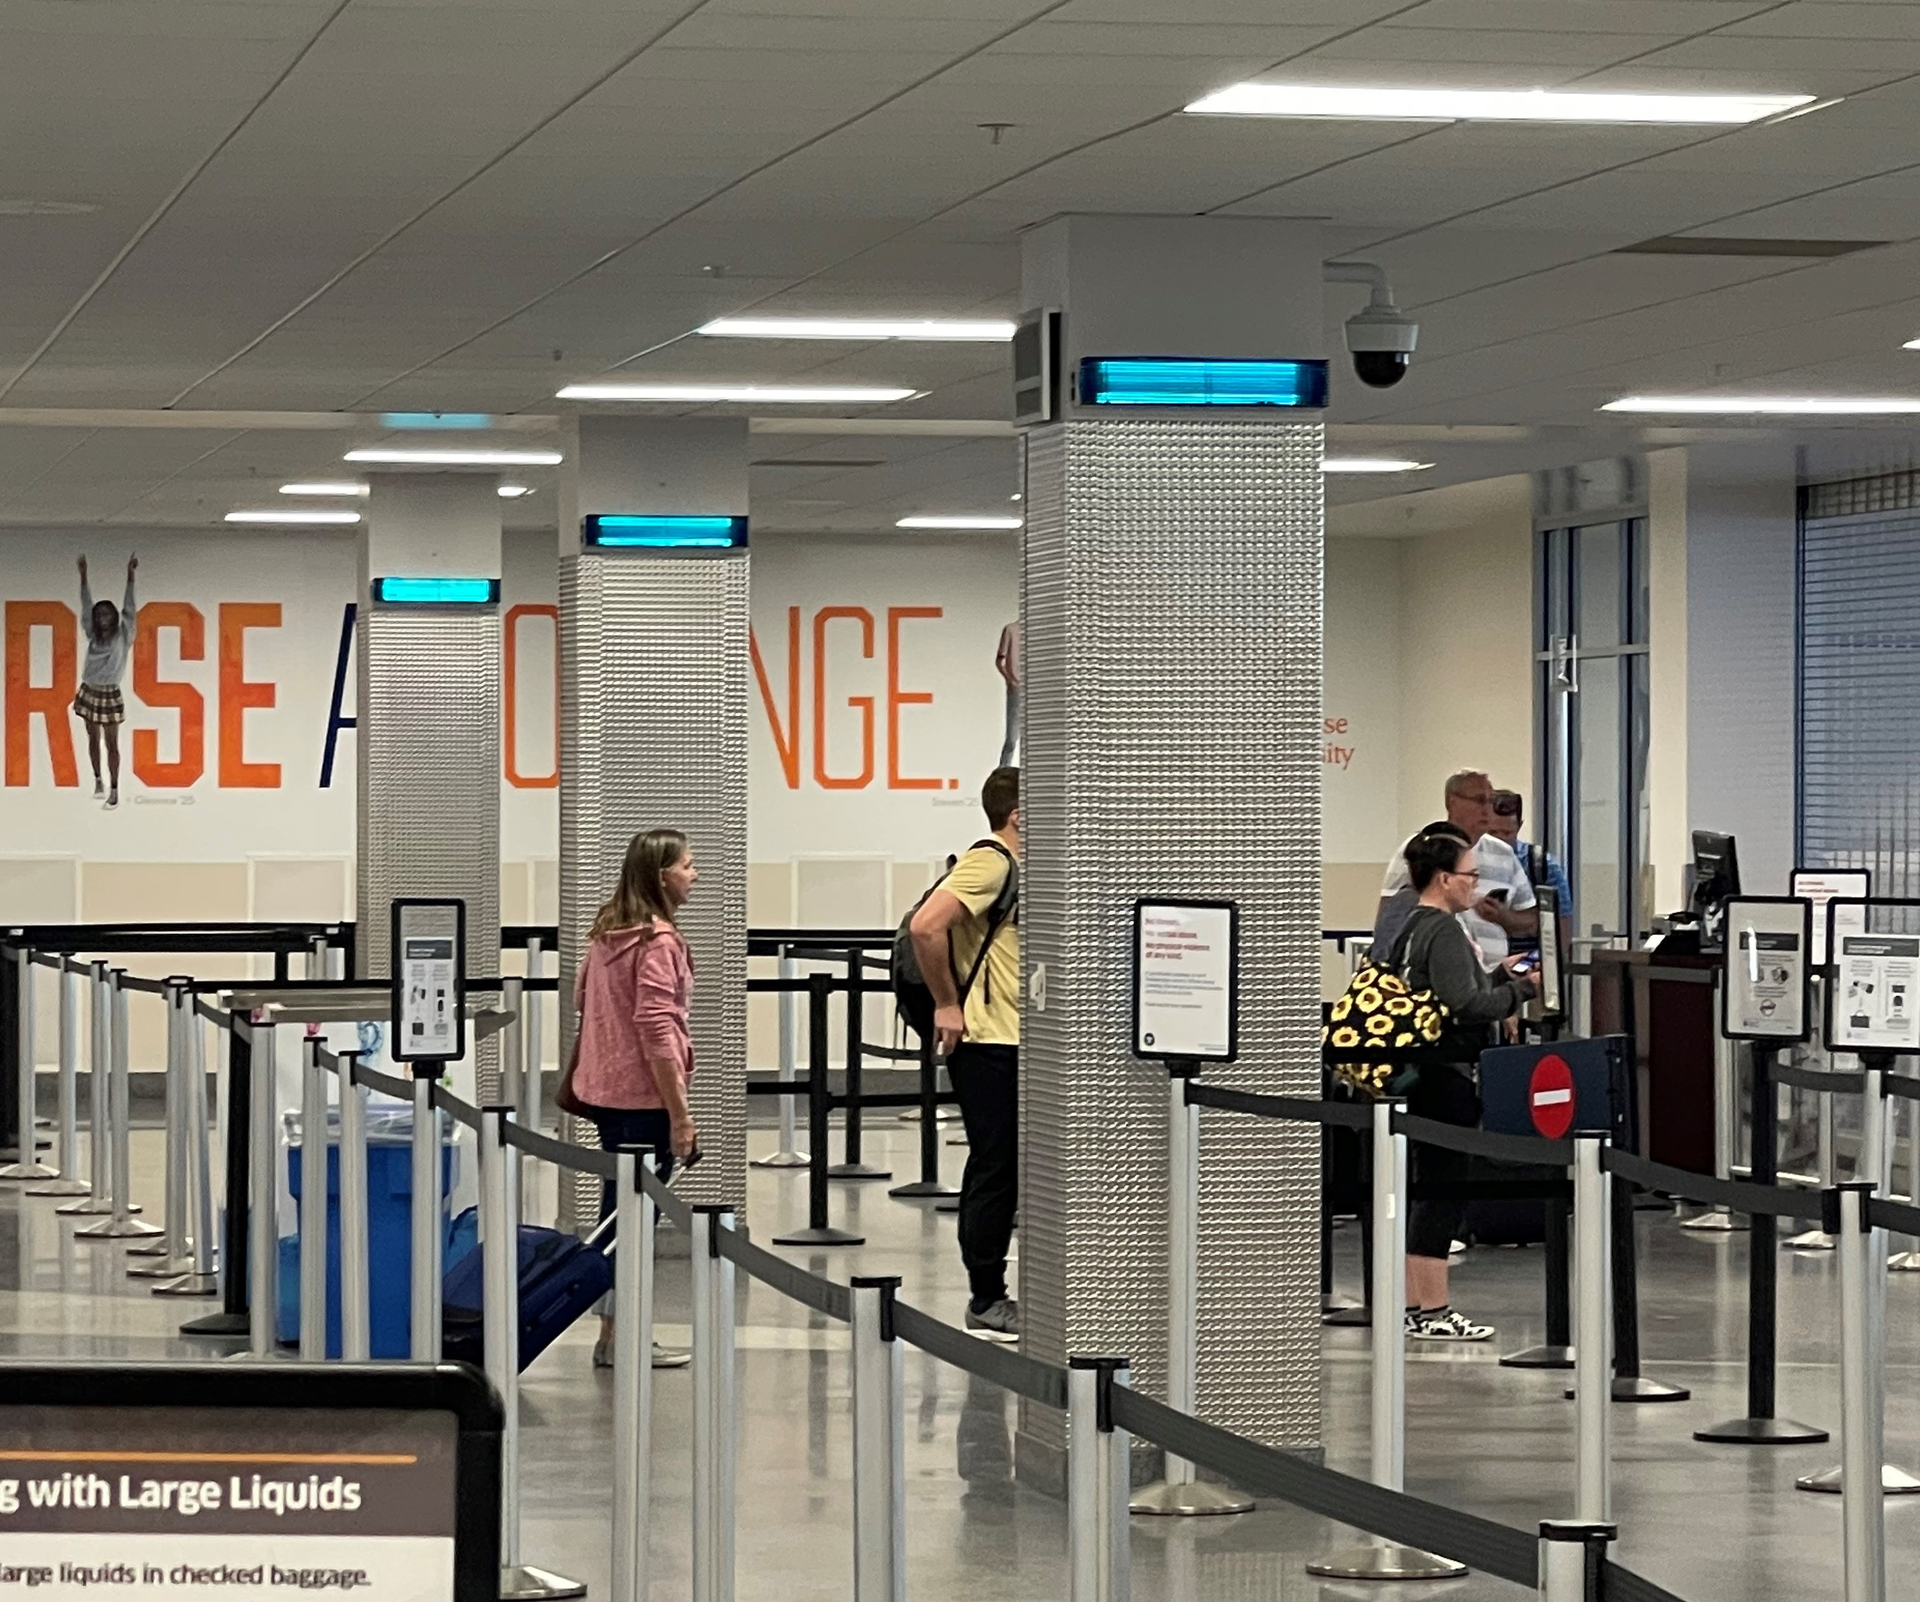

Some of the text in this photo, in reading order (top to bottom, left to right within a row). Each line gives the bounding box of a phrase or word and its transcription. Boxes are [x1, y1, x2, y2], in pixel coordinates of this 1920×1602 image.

[5, 601, 282, 788] RSE
[27, 1472, 111, 1508] with
[119, 1475, 222, 1516] Large
[230, 1474, 362, 1516] Liquids
[60, 1561, 136, 1586] liquids
[143, 1562, 164, 1584] in
[170, 1563, 264, 1586] checked
[271, 1564, 372, 1590] baggage.
